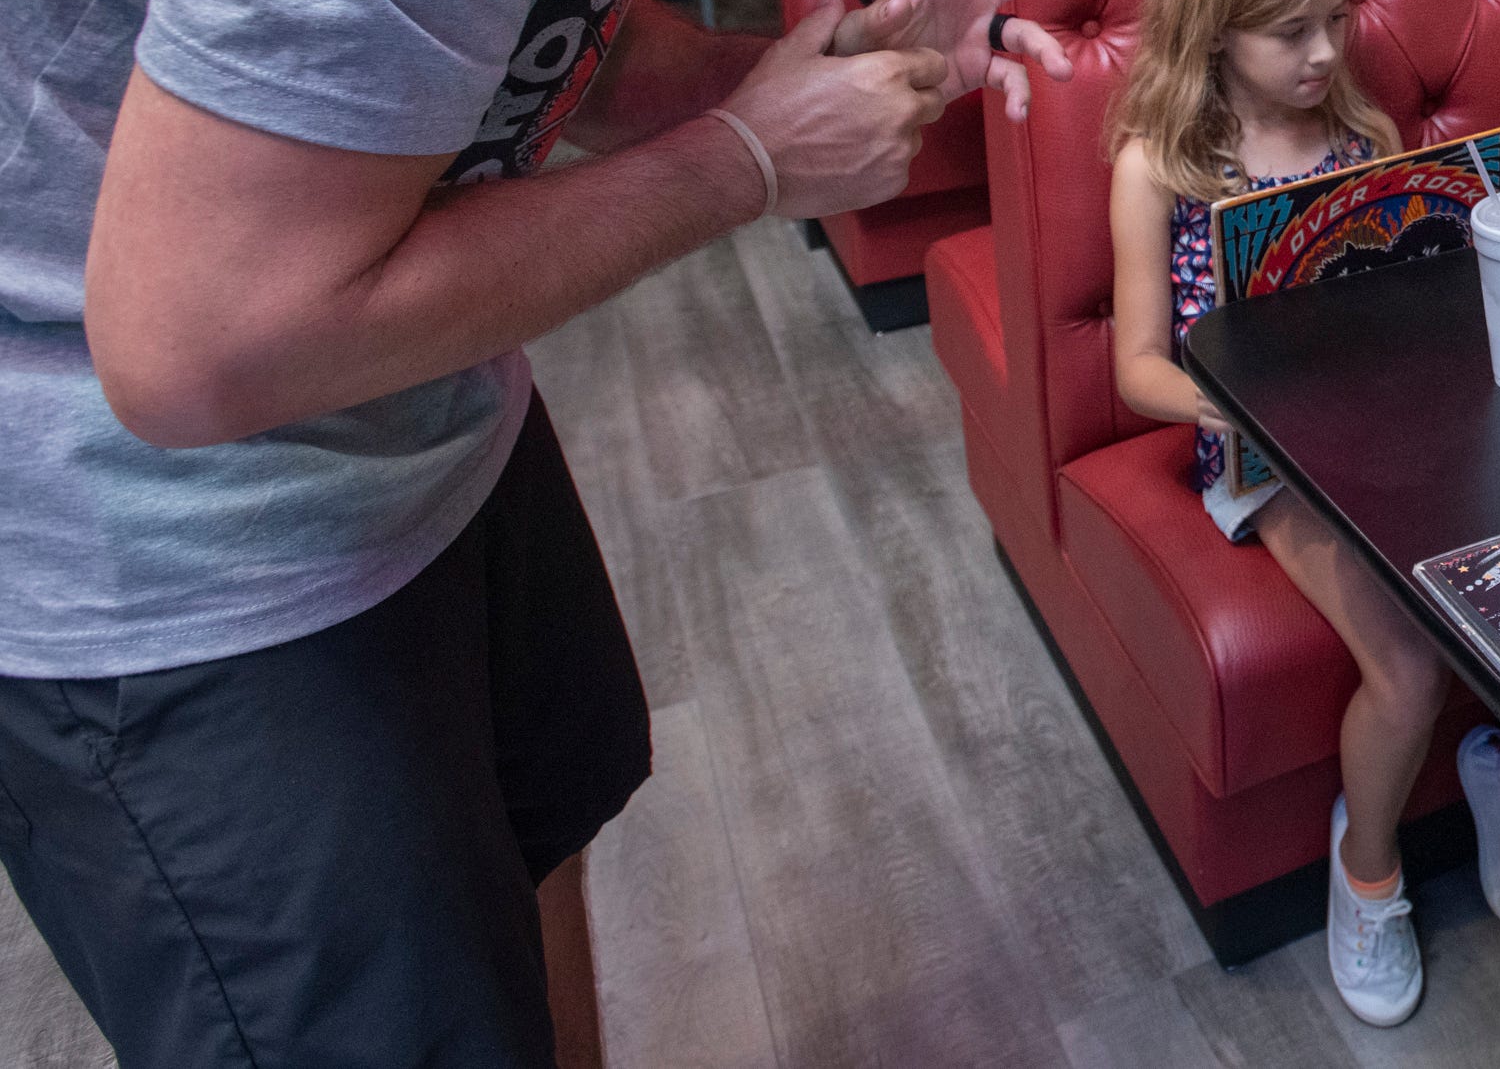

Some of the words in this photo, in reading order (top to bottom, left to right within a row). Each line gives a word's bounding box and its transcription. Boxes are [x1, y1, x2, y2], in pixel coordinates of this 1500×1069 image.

[1223, 194, 1294, 241] KISS
[1290, 185, 1368, 255] OVER
[1403, 174, 1485, 204] ROCK
